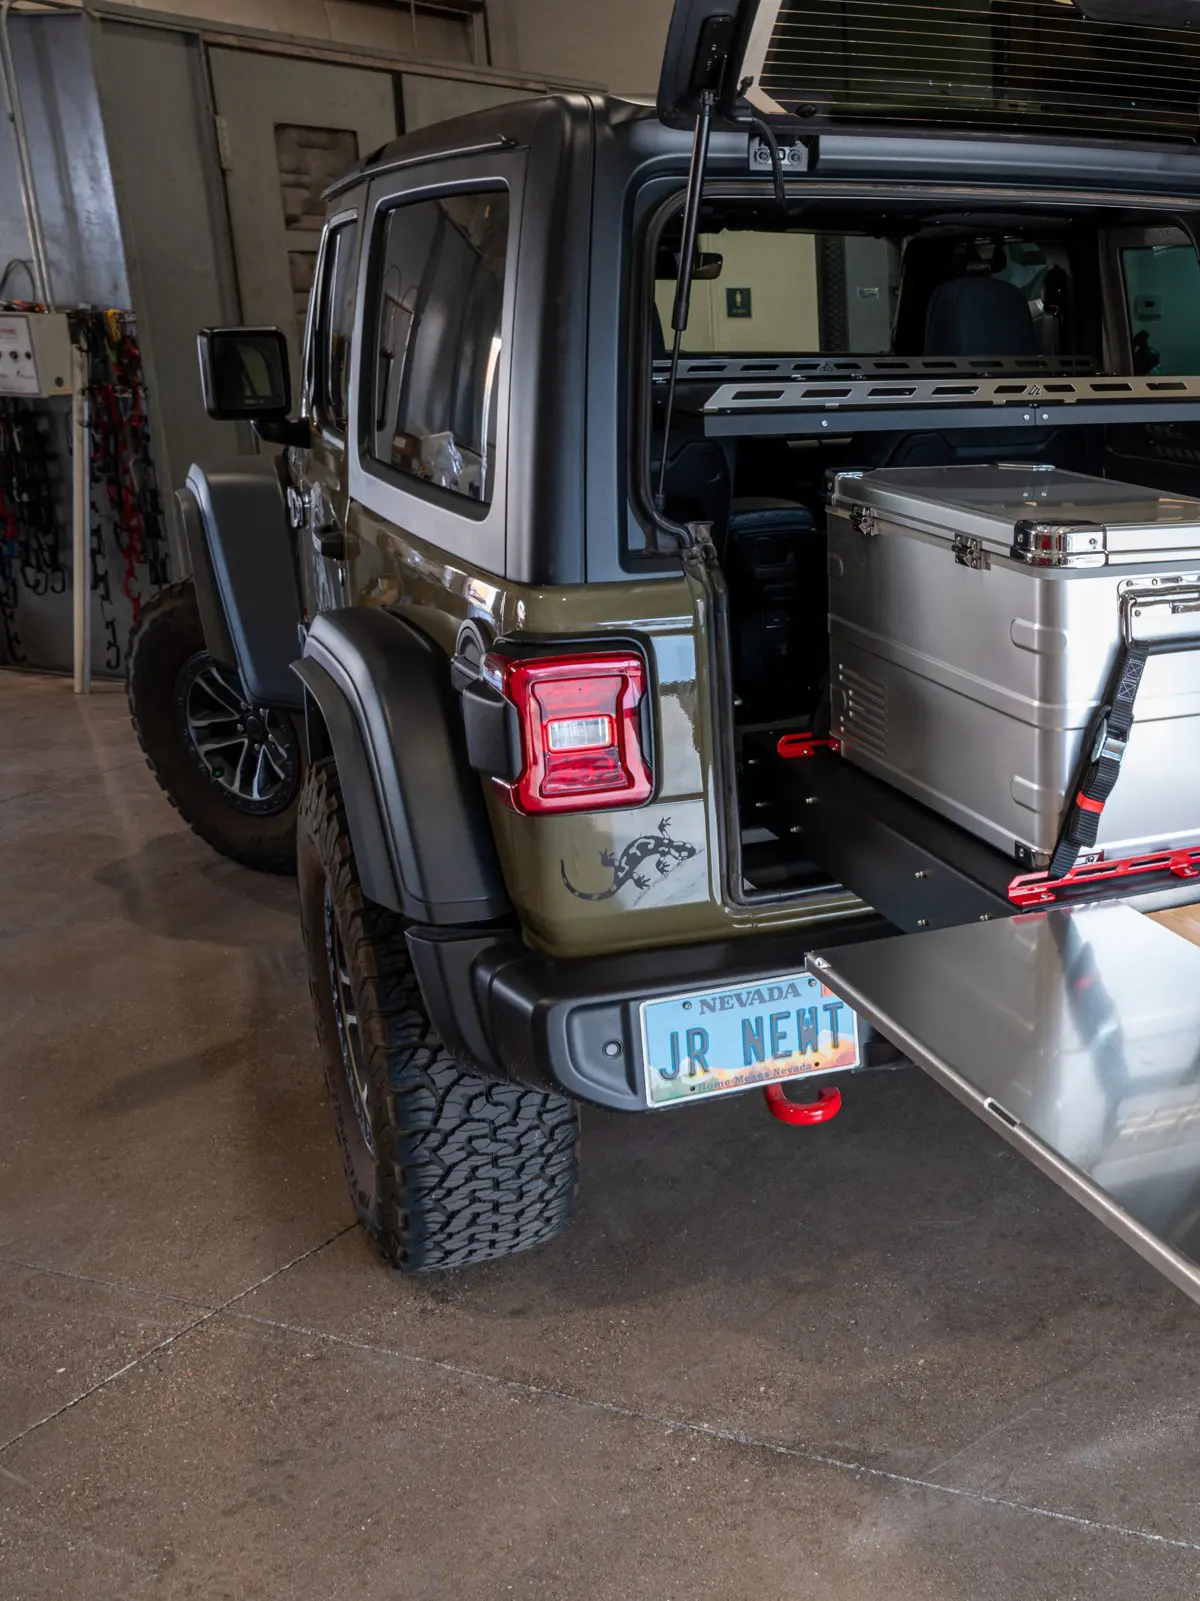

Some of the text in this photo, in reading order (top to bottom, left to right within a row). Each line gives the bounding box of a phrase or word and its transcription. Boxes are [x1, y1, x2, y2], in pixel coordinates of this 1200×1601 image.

[699, 982, 802, 1015] NEVADA
[659, 1002, 844, 1080] JR NEWT
[698, 1063, 812, 1091] Home Means Nevada
